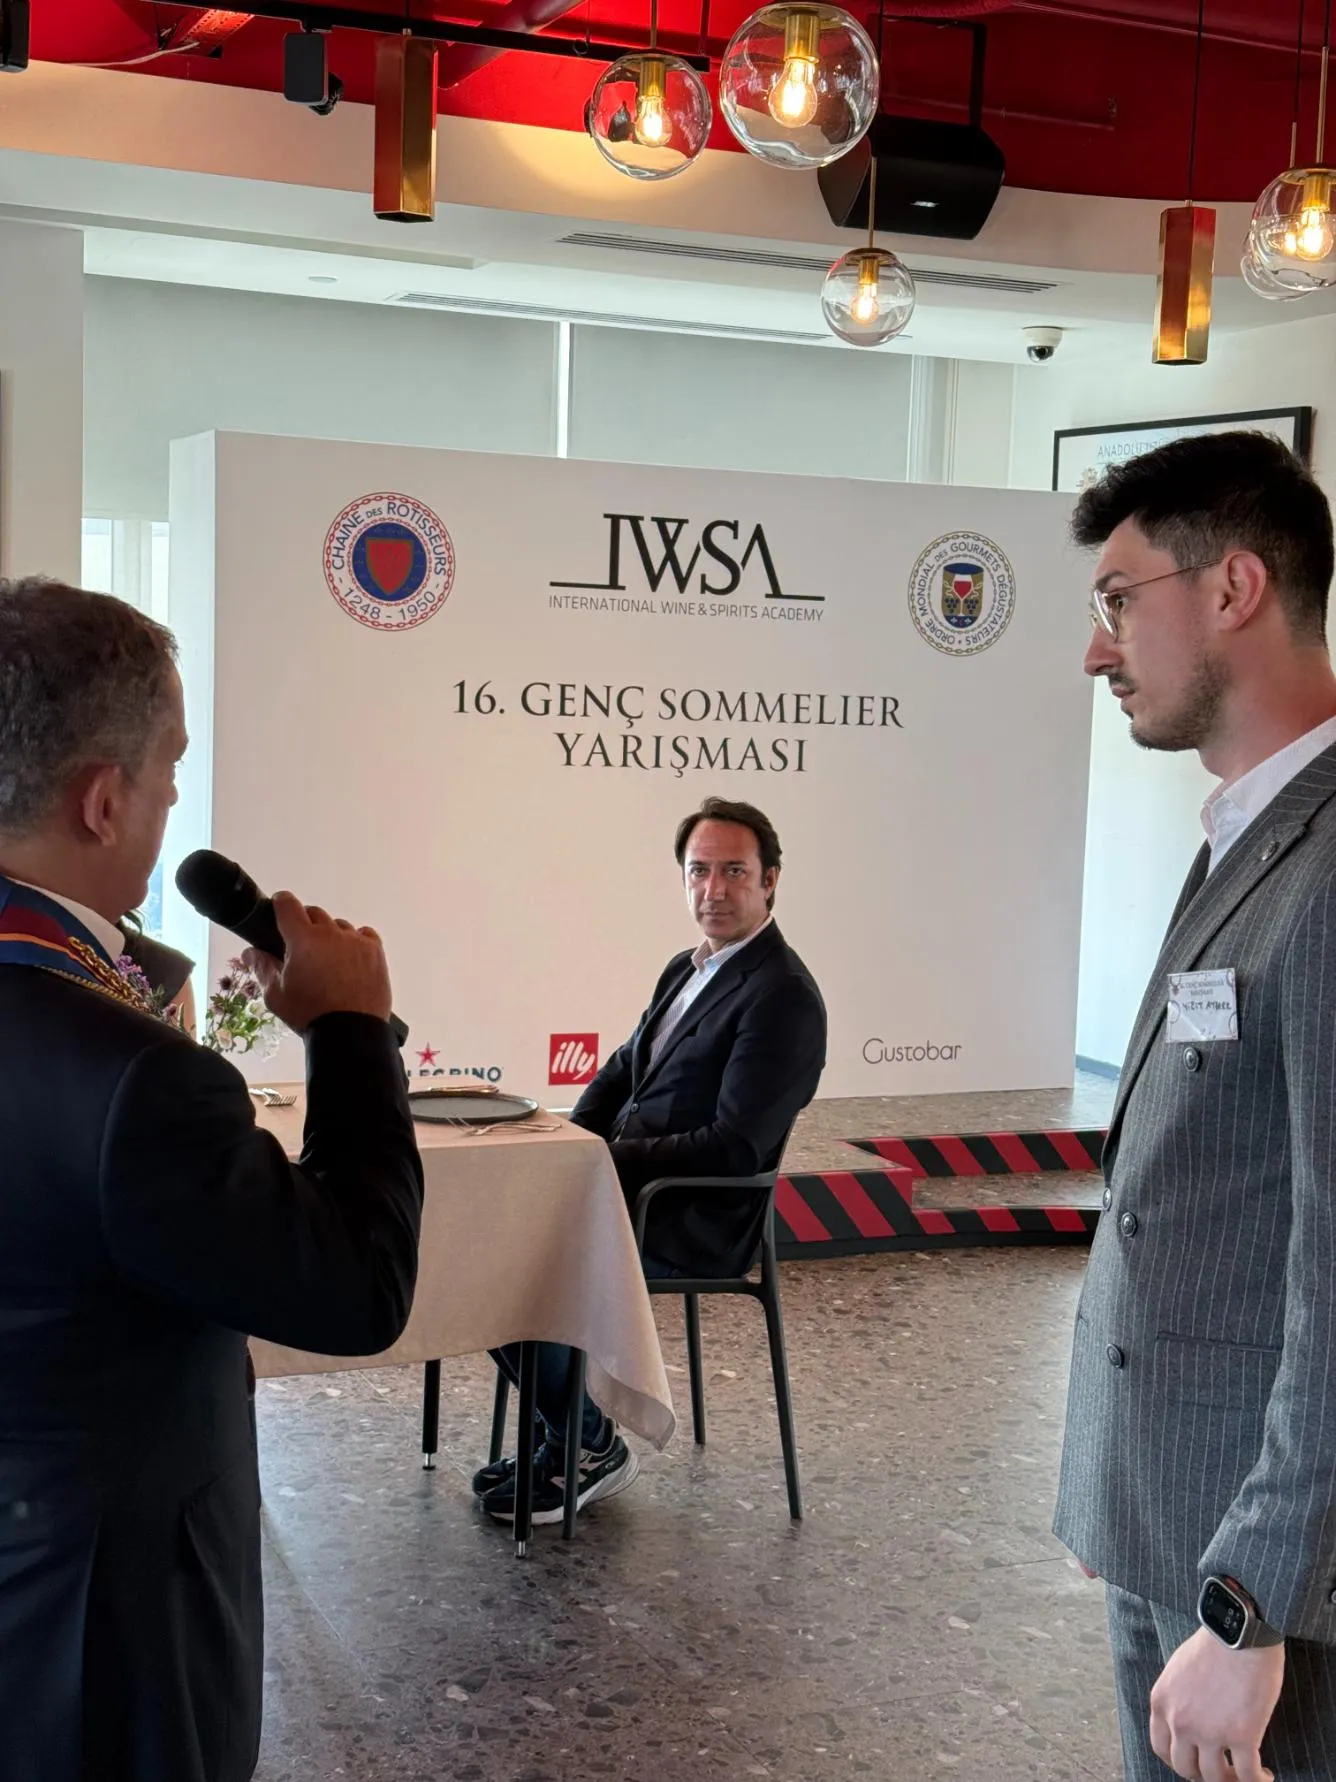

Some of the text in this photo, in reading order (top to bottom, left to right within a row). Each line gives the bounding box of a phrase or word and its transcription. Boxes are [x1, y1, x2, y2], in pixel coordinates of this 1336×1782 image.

[332, 502, 447, 576] CHAINE DES ROTISSEURS
[934, 549, 948, 562] DES
[549, 513, 825, 601] IWSA
[950, 542, 1001, 572] GOURMETS
[344, 588, 381, 620] 1248
[398, 591, 436, 620] 1950
[917, 562, 935, 617] MONDIAL
[549, 595, 824, 621] INTERNATIONAL WINE & SPIRITS ACADEMY
[925, 618, 955, 645] ORDRE
[452, 679, 905, 729] 16. GENÇ SOMMELIER
[554, 732, 808, 778] YARIŞMASI
[551, 1041, 595, 1080] illy
[863, 1038, 962, 1064] Gustobar
